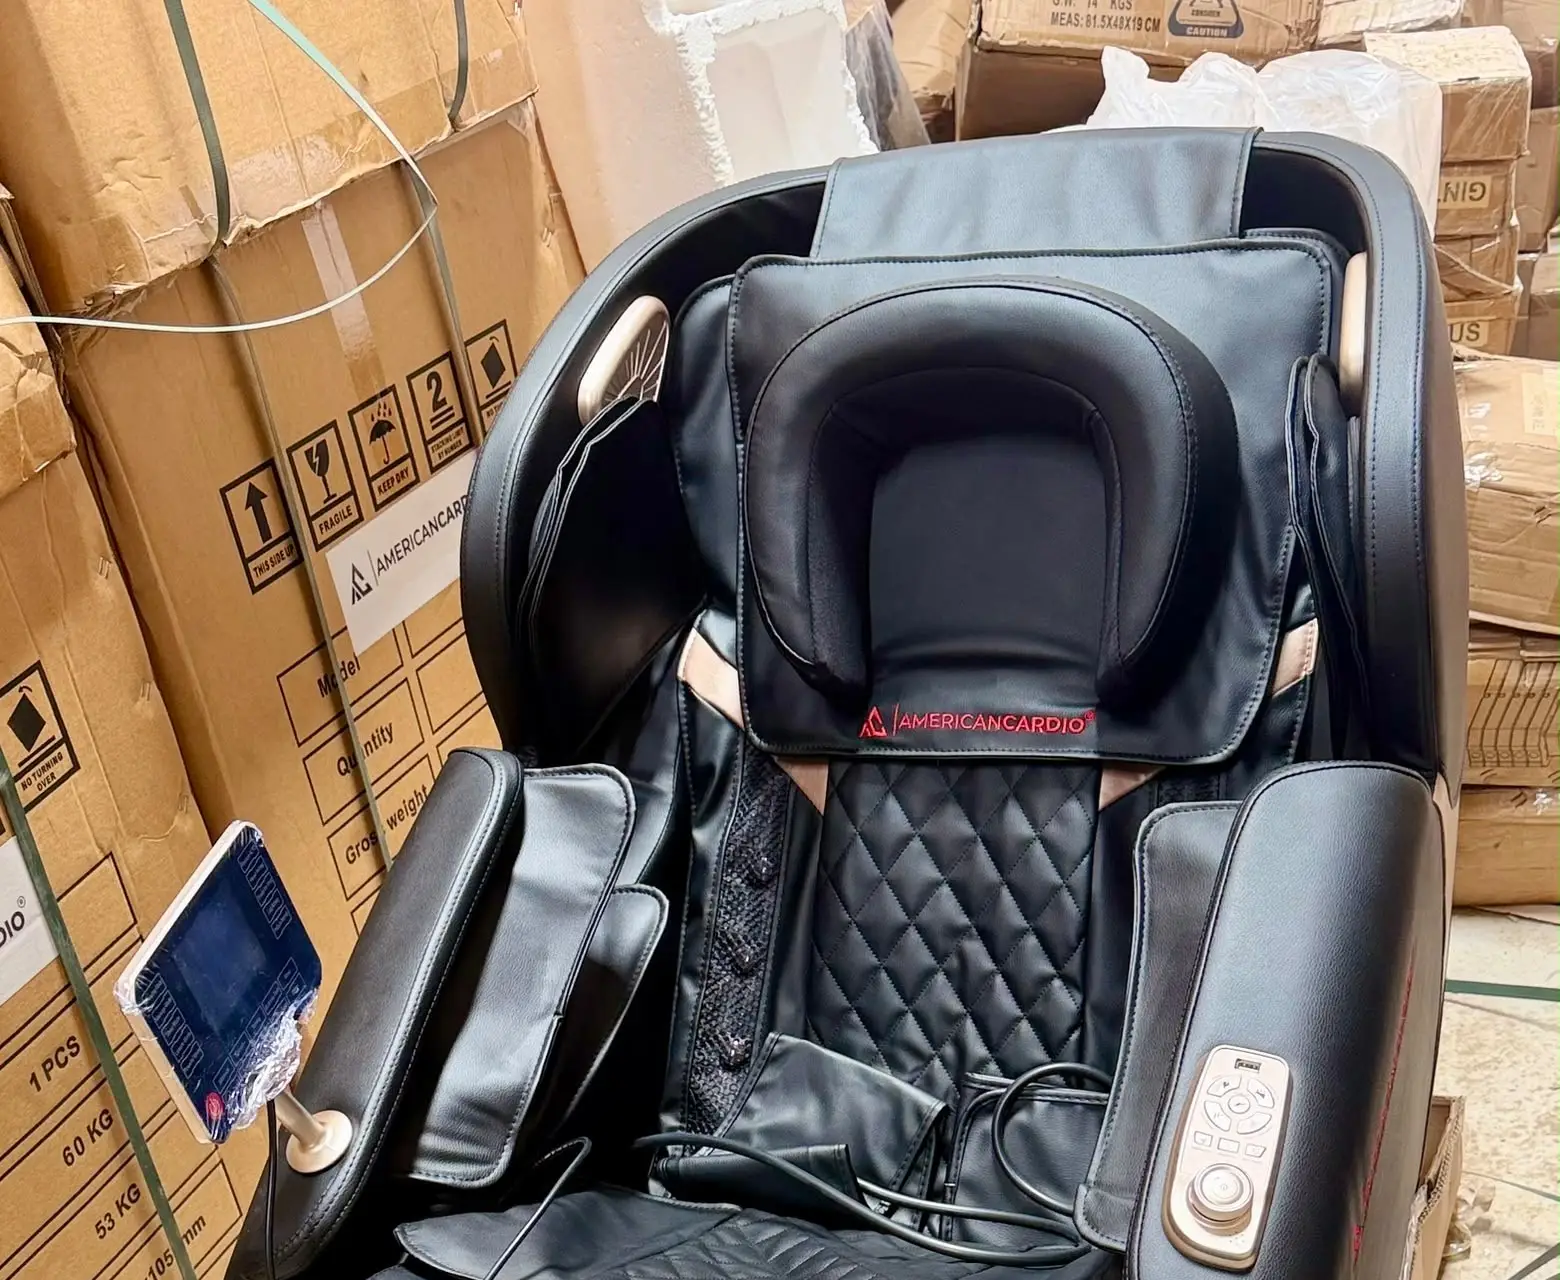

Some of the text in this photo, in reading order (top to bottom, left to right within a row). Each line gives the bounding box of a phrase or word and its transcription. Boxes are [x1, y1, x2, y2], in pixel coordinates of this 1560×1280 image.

[1050, 11, 1084, 28] MEAS:
[1144, 16, 1161, 33] CM
[1186, 26, 1228, 37] CAUTION
[426, 370, 448, 413] 2
[376, 466, 411, 496] KEEP DRY
[318, 504, 354, 535] FRAGILE
[252, 542, 295, 578] THIS SIDE UP
[336, 722, 394, 777] Quntity
[20, 751, 64, 791] NO TURNING
[36, 771, 57, 792] OVER
[345, 783, 429, 865] Gros weight
[29, 1034, 81, 1093] 1 PCS
[62, 1108, 114, 1167] 60 KG
[94, 1183, 141, 1240] 53 KG
